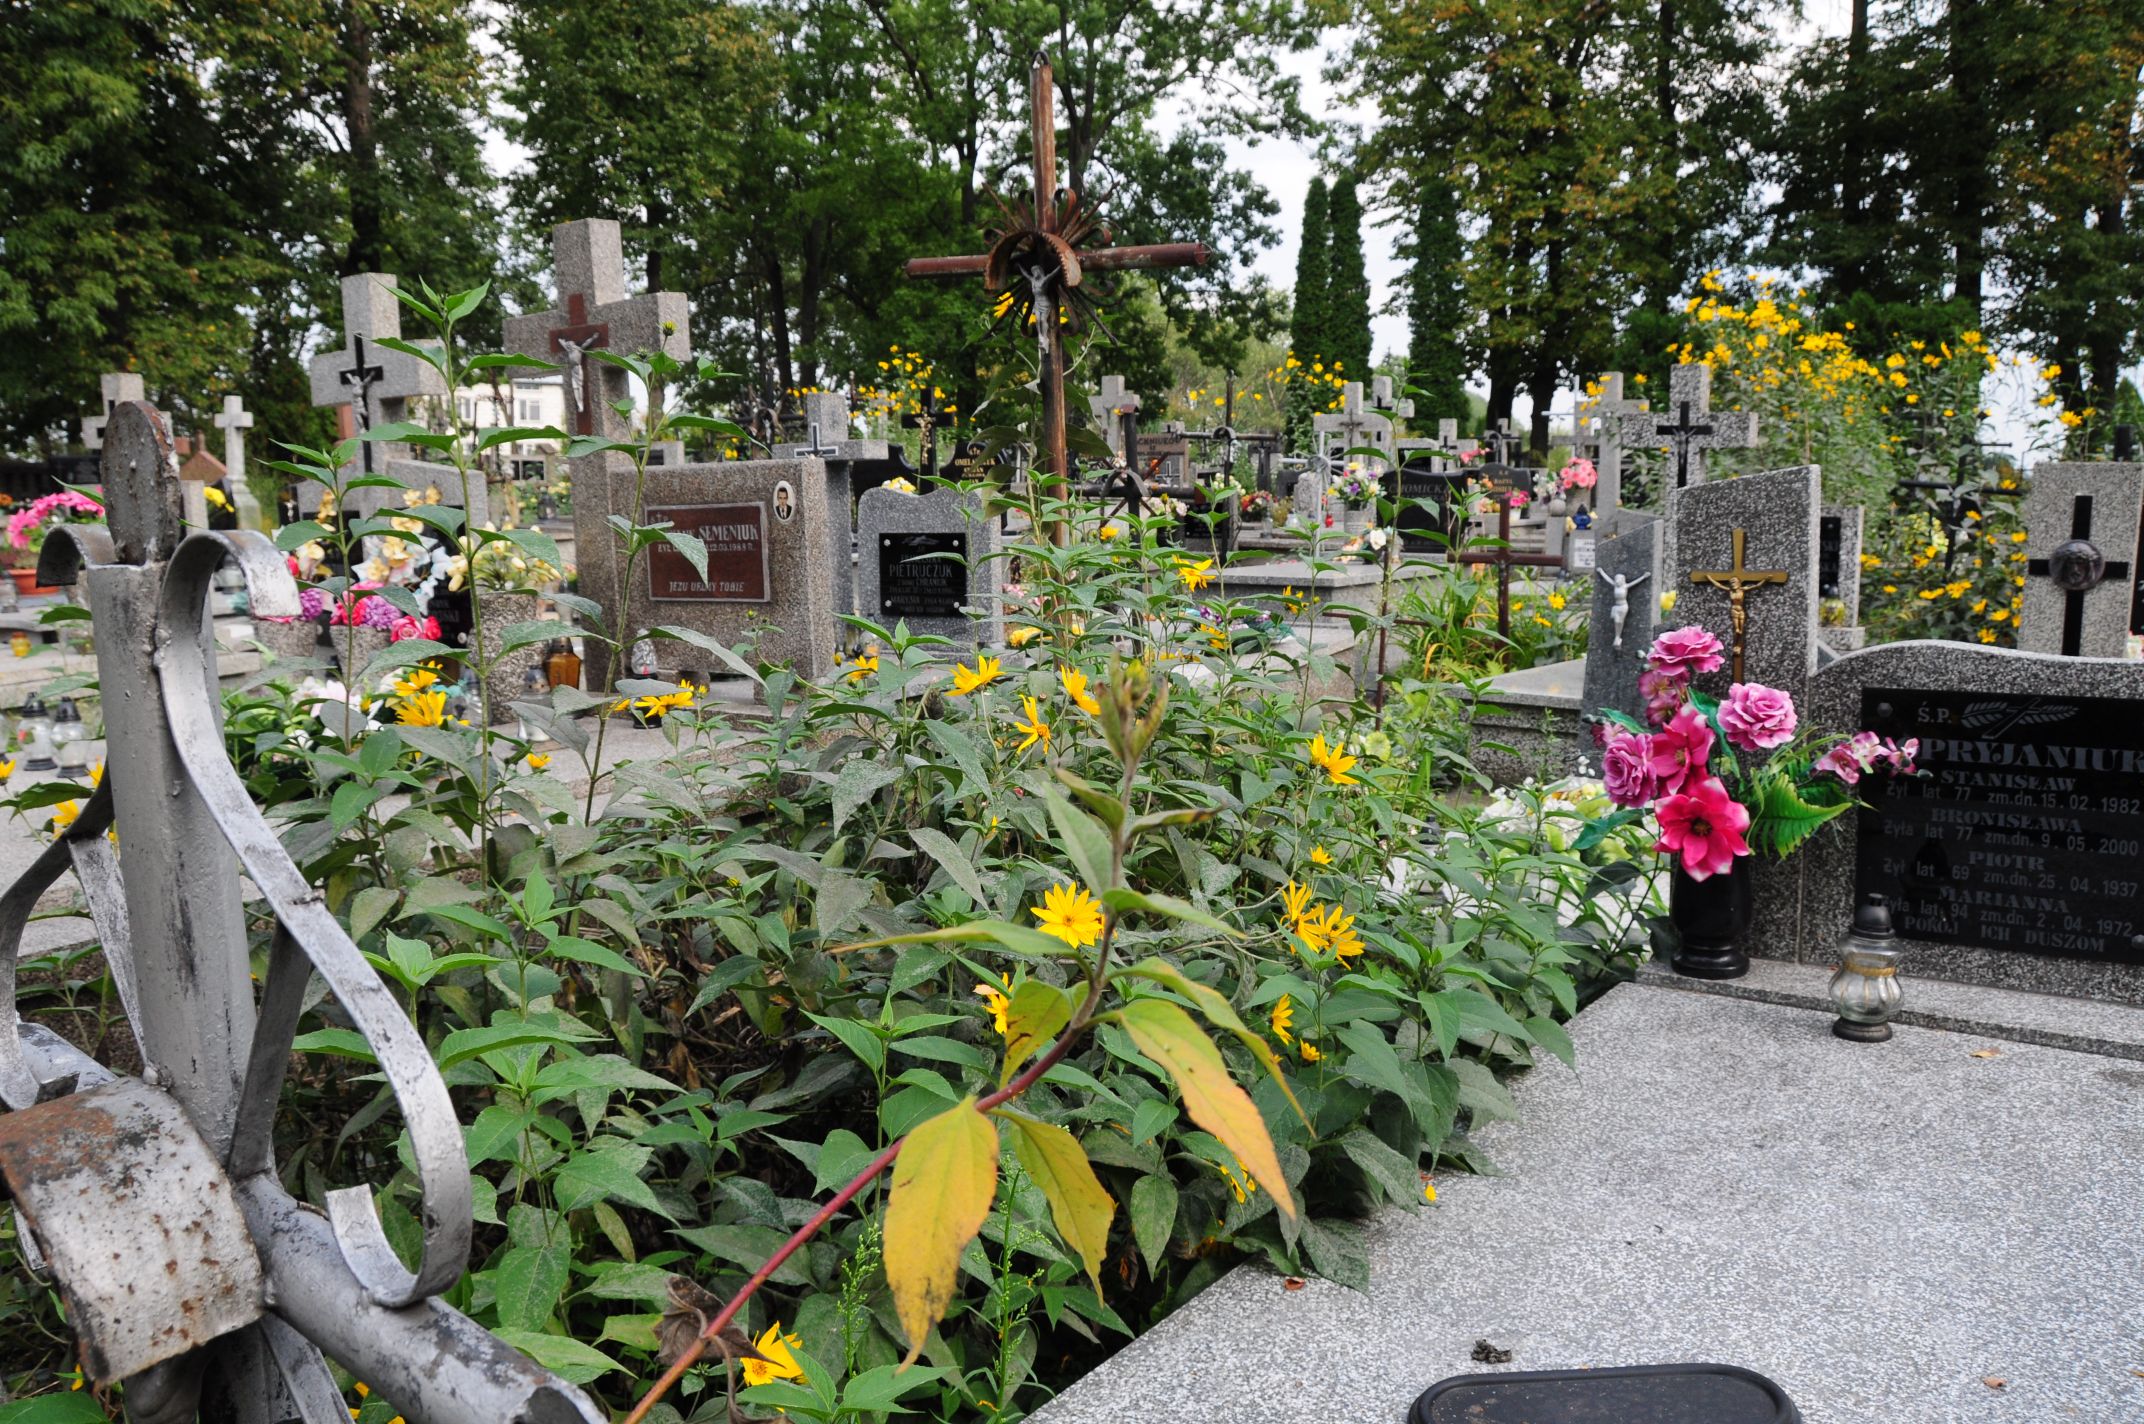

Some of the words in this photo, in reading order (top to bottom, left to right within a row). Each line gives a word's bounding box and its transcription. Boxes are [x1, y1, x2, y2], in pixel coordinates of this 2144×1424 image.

[698, 524, 759, 541] SEMENIUK
[889, 563, 953, 578] PIETRUCZUK
[669, 581, 689, 593] JEZU
[719, 581, 745, 592] TOBIE
[1920, 737, 2144, 774] PRYJANIUK
[1941, 769, 2078, 792] STANISŁAW
[1922, 782, 1942, 800] lat
[1954, 785, 1972, 801] 77
[1930, 807, 2083, 833] BRONISŁAWA
[1924, 822, 1945, 840] lat
[1955, 825, 1974, 841] 77
[1916, 860, 1936, 878] lat
[1952, 864, 1970, 881] 69
[1968, 850, 2046, 871] PIOTR
[1920, 899, 1938, 916] lat
[1951, 903, 1968, 920] 94
[1938, 885, 2070, 913] MARIANNA
[1980, 924, 2011, 942] ICH
[2024, 929, 2106, 953] DUSZOM
